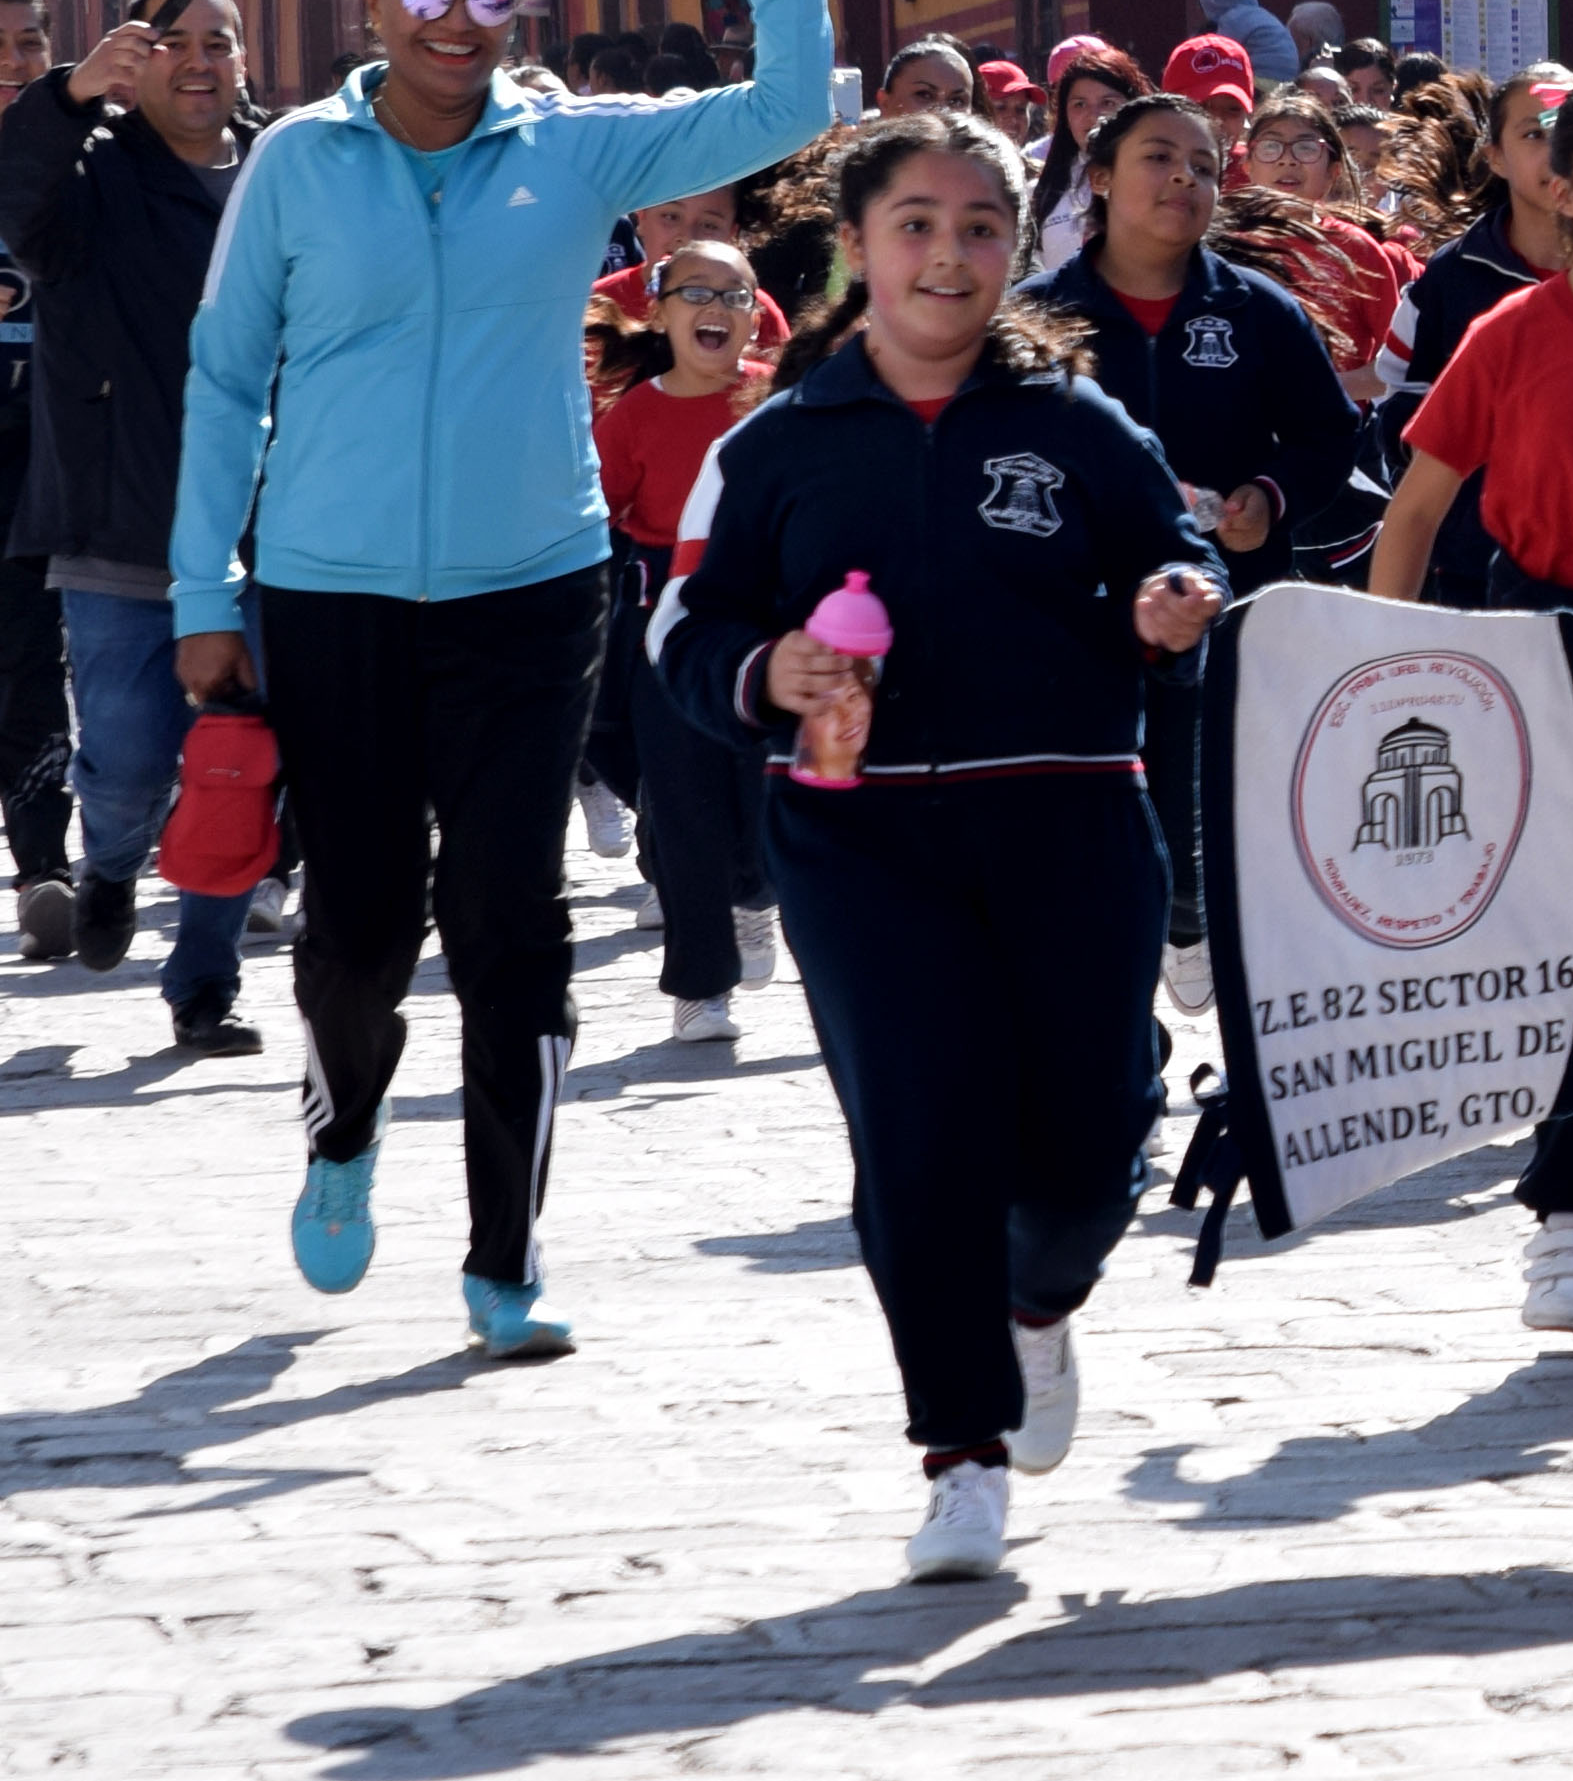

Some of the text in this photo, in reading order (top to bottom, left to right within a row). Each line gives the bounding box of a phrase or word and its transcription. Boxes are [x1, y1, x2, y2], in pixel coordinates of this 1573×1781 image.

[1378, 965, 1528, 1015] SECTOR
[1268, 1019, 1566, 1102] SAN MIGUEL DE
[1285, 1086, 1545, 1171] ALLENDE, GTO.
